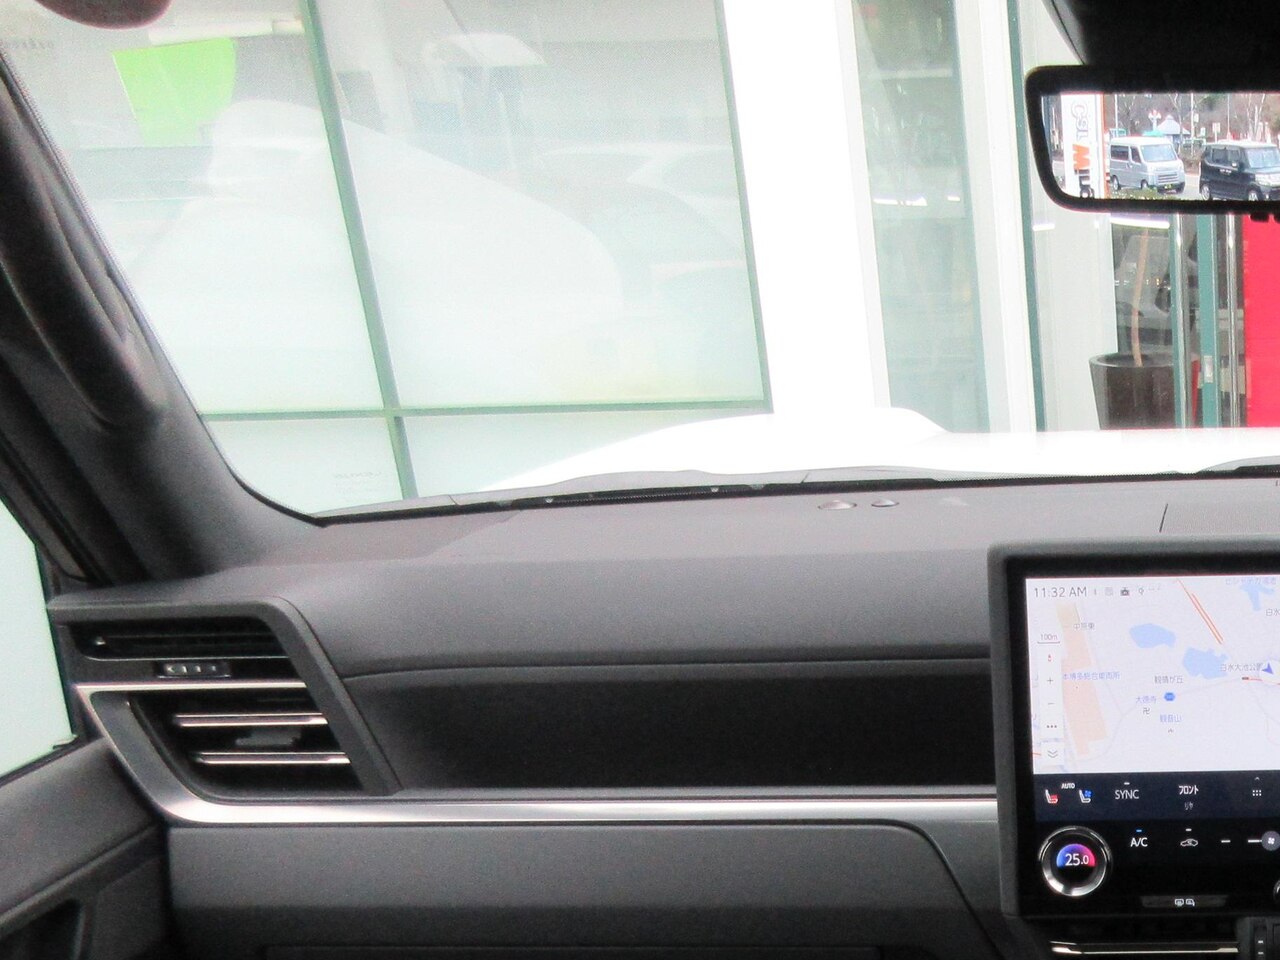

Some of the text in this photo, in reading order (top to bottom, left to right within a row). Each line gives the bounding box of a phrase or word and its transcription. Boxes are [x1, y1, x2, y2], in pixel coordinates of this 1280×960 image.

[1034, 586, 1088, 598] 11:32 AM
[1040, 633, 1058, 641] 100m
[1114, 789, 1139, 800] SYNC
[1178, 784, 1199, 795] フロント
[1130, 837, 1148, 848] A/C
[1065, 853, 1090, 866] 25.0
